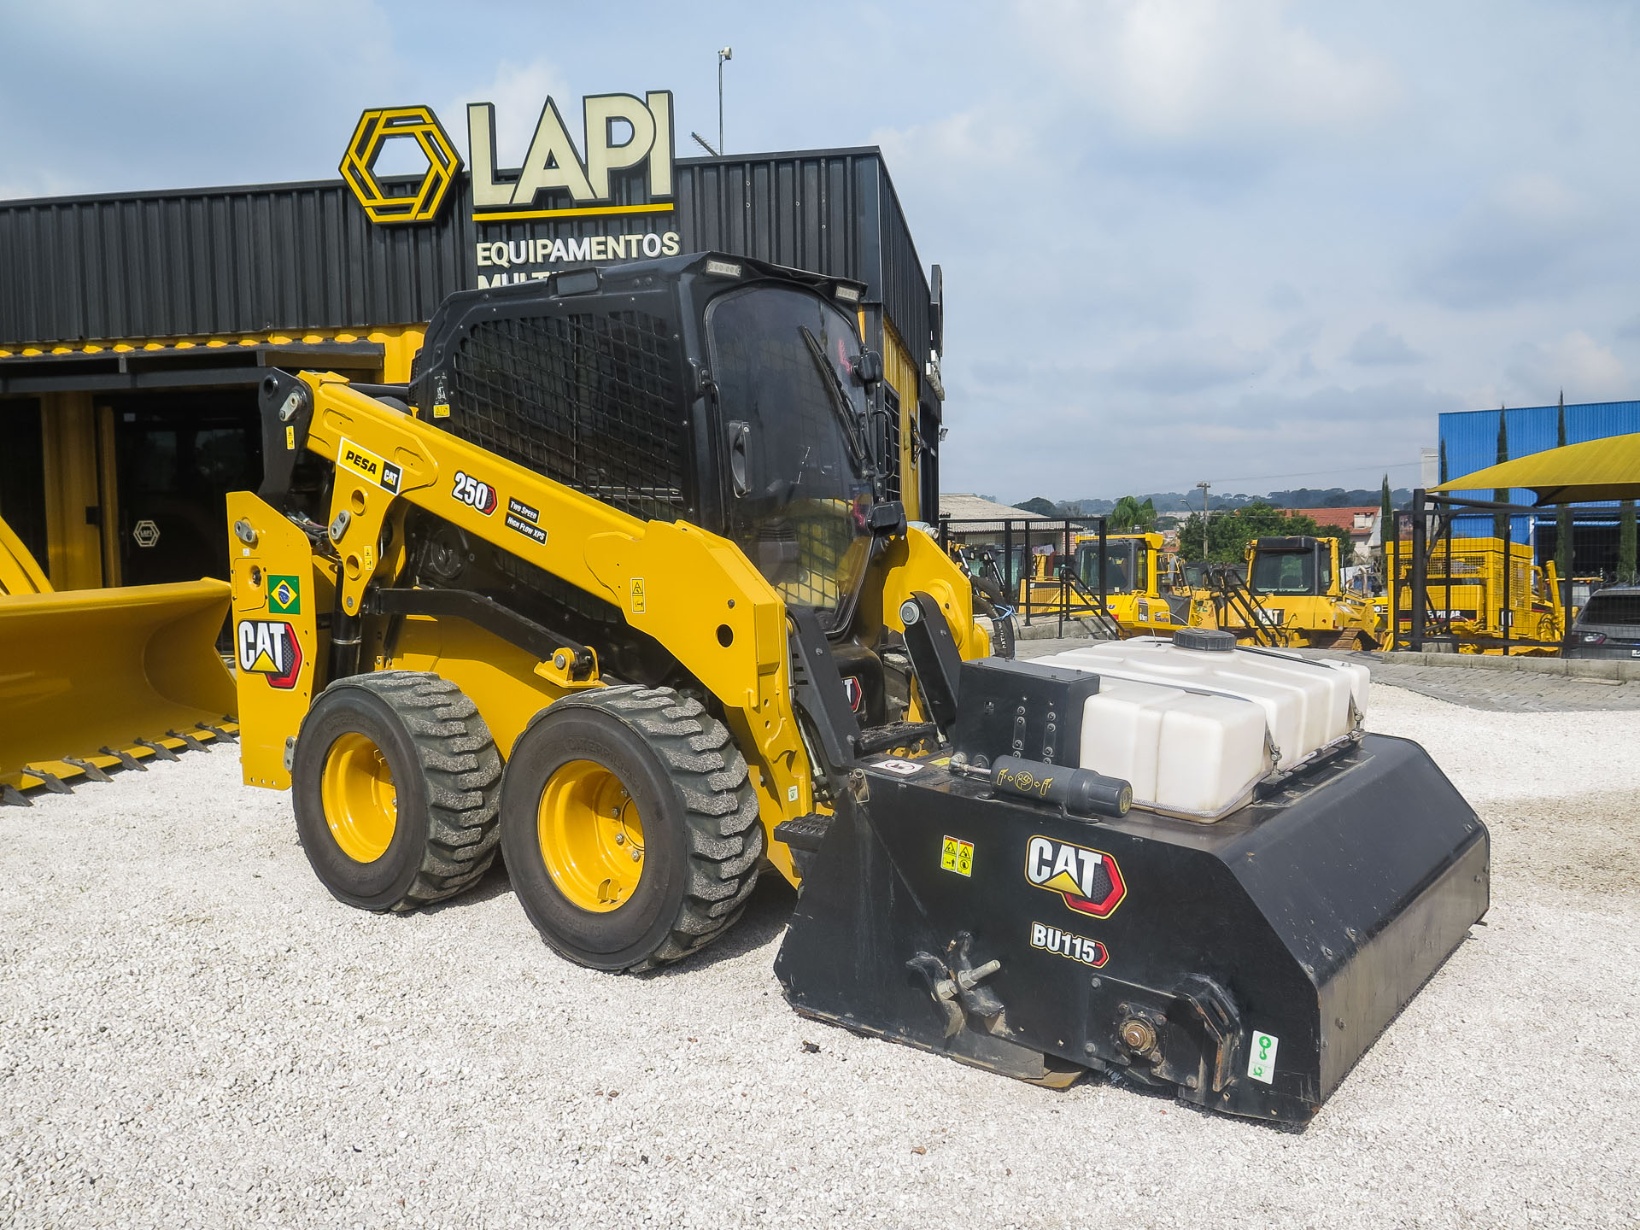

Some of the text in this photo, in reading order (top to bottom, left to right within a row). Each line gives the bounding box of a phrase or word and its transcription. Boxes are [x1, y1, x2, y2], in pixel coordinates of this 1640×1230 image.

[467, 90, 674, 207] LAPI
[476, 231, 681, 268] EQUIPAMENTOS
[345, 450, 398, 486] PESA CAT
[454, 472, 489, 510] 250
[532, 529, 546, 541] XPS
[238, 620, 286, 674] CAT
[1027, 837, 1103, 899] CAT
[1032, 923, 1096, 963] BU115
